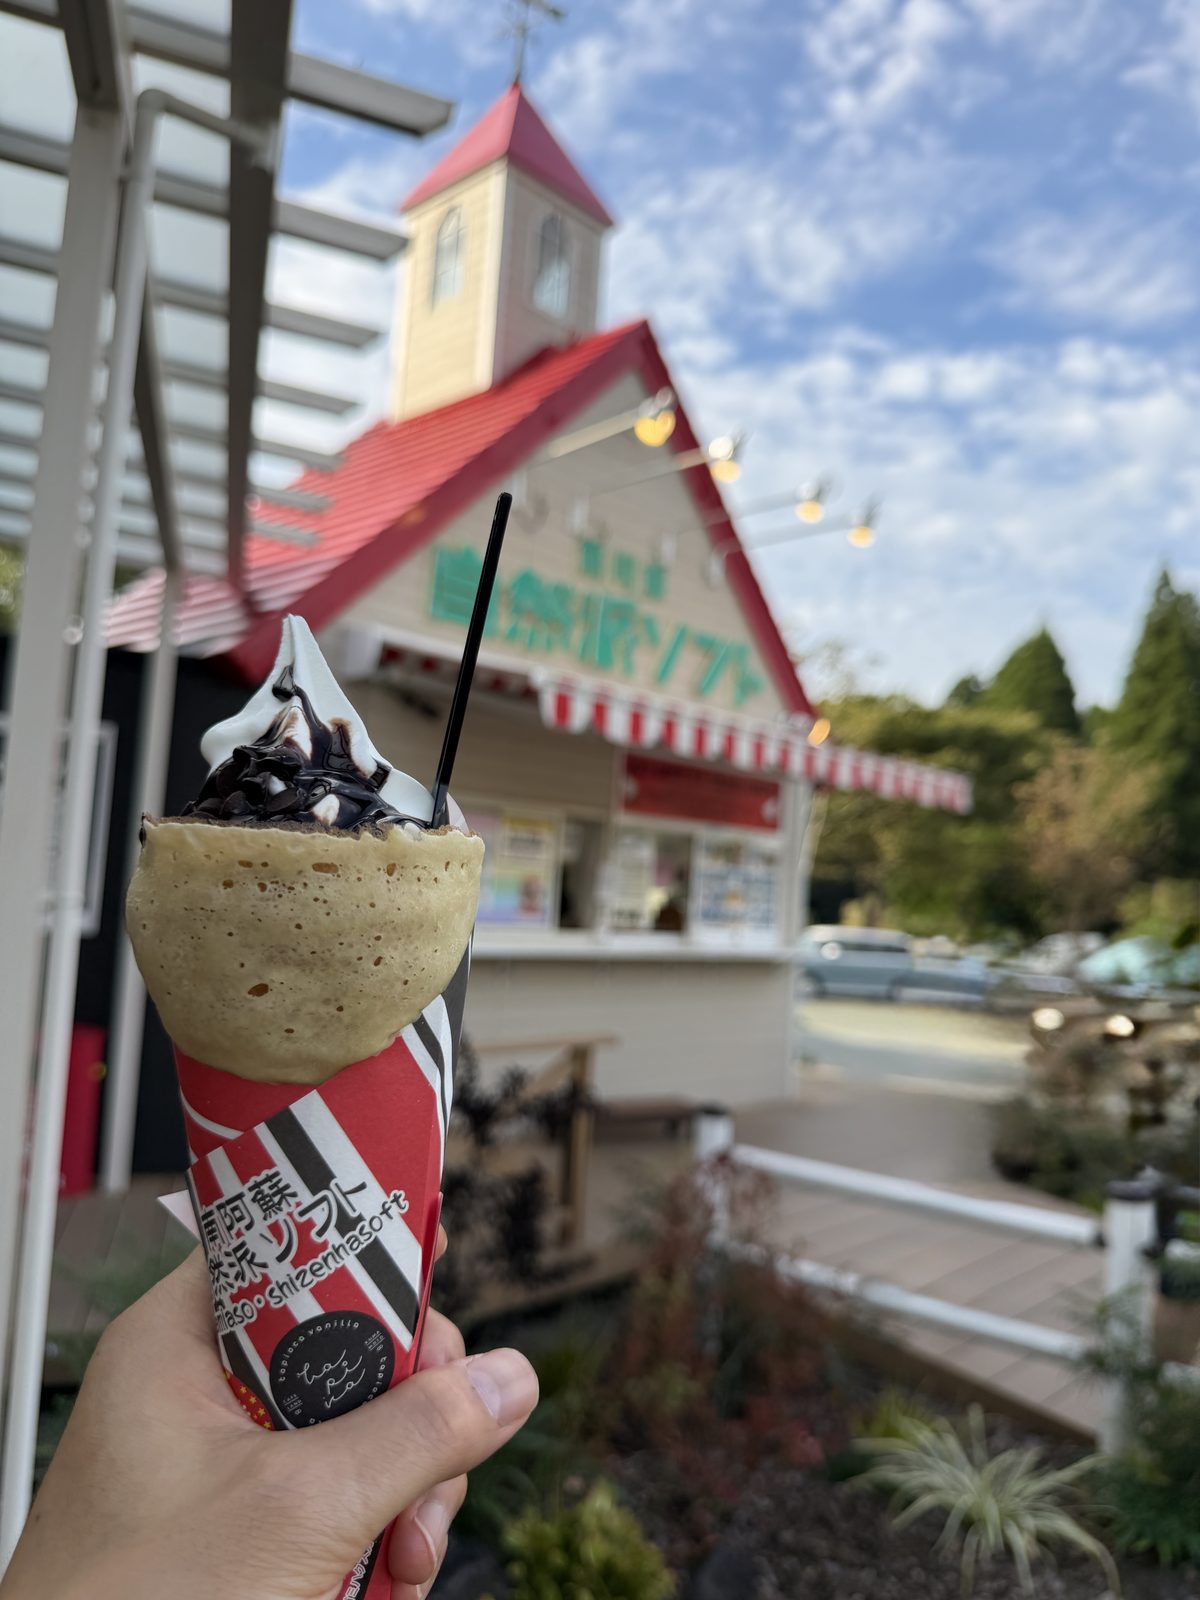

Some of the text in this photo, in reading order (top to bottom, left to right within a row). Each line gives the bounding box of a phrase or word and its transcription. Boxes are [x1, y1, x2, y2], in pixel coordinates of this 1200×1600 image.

[279, 1320, 360, 1382] tapioca vanilla
[364, 1356, 388, 1403] tapioc
